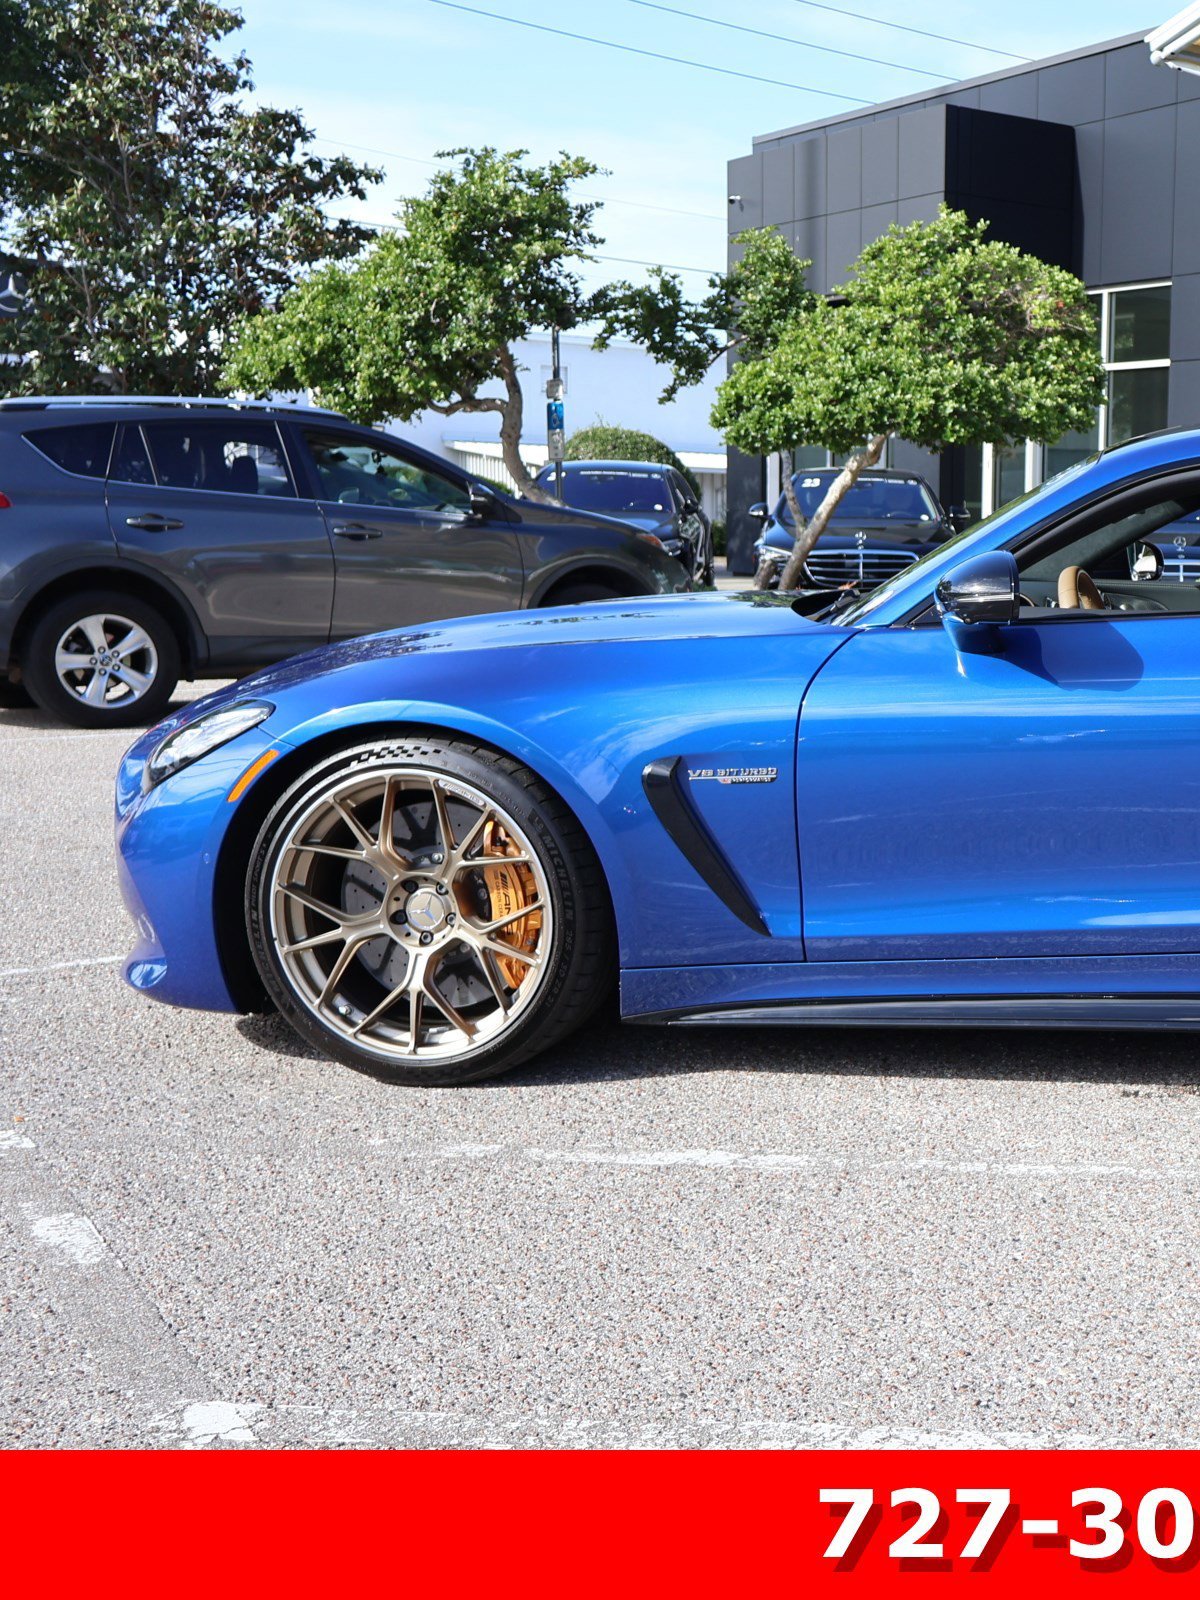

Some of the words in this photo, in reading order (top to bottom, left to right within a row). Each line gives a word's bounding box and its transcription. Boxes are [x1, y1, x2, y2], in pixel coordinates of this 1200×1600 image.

[688, 769, 714, 777] V8
[717, 767, 777, 776] BITURBO
[542, 834, 575, 922] MICHELIN
